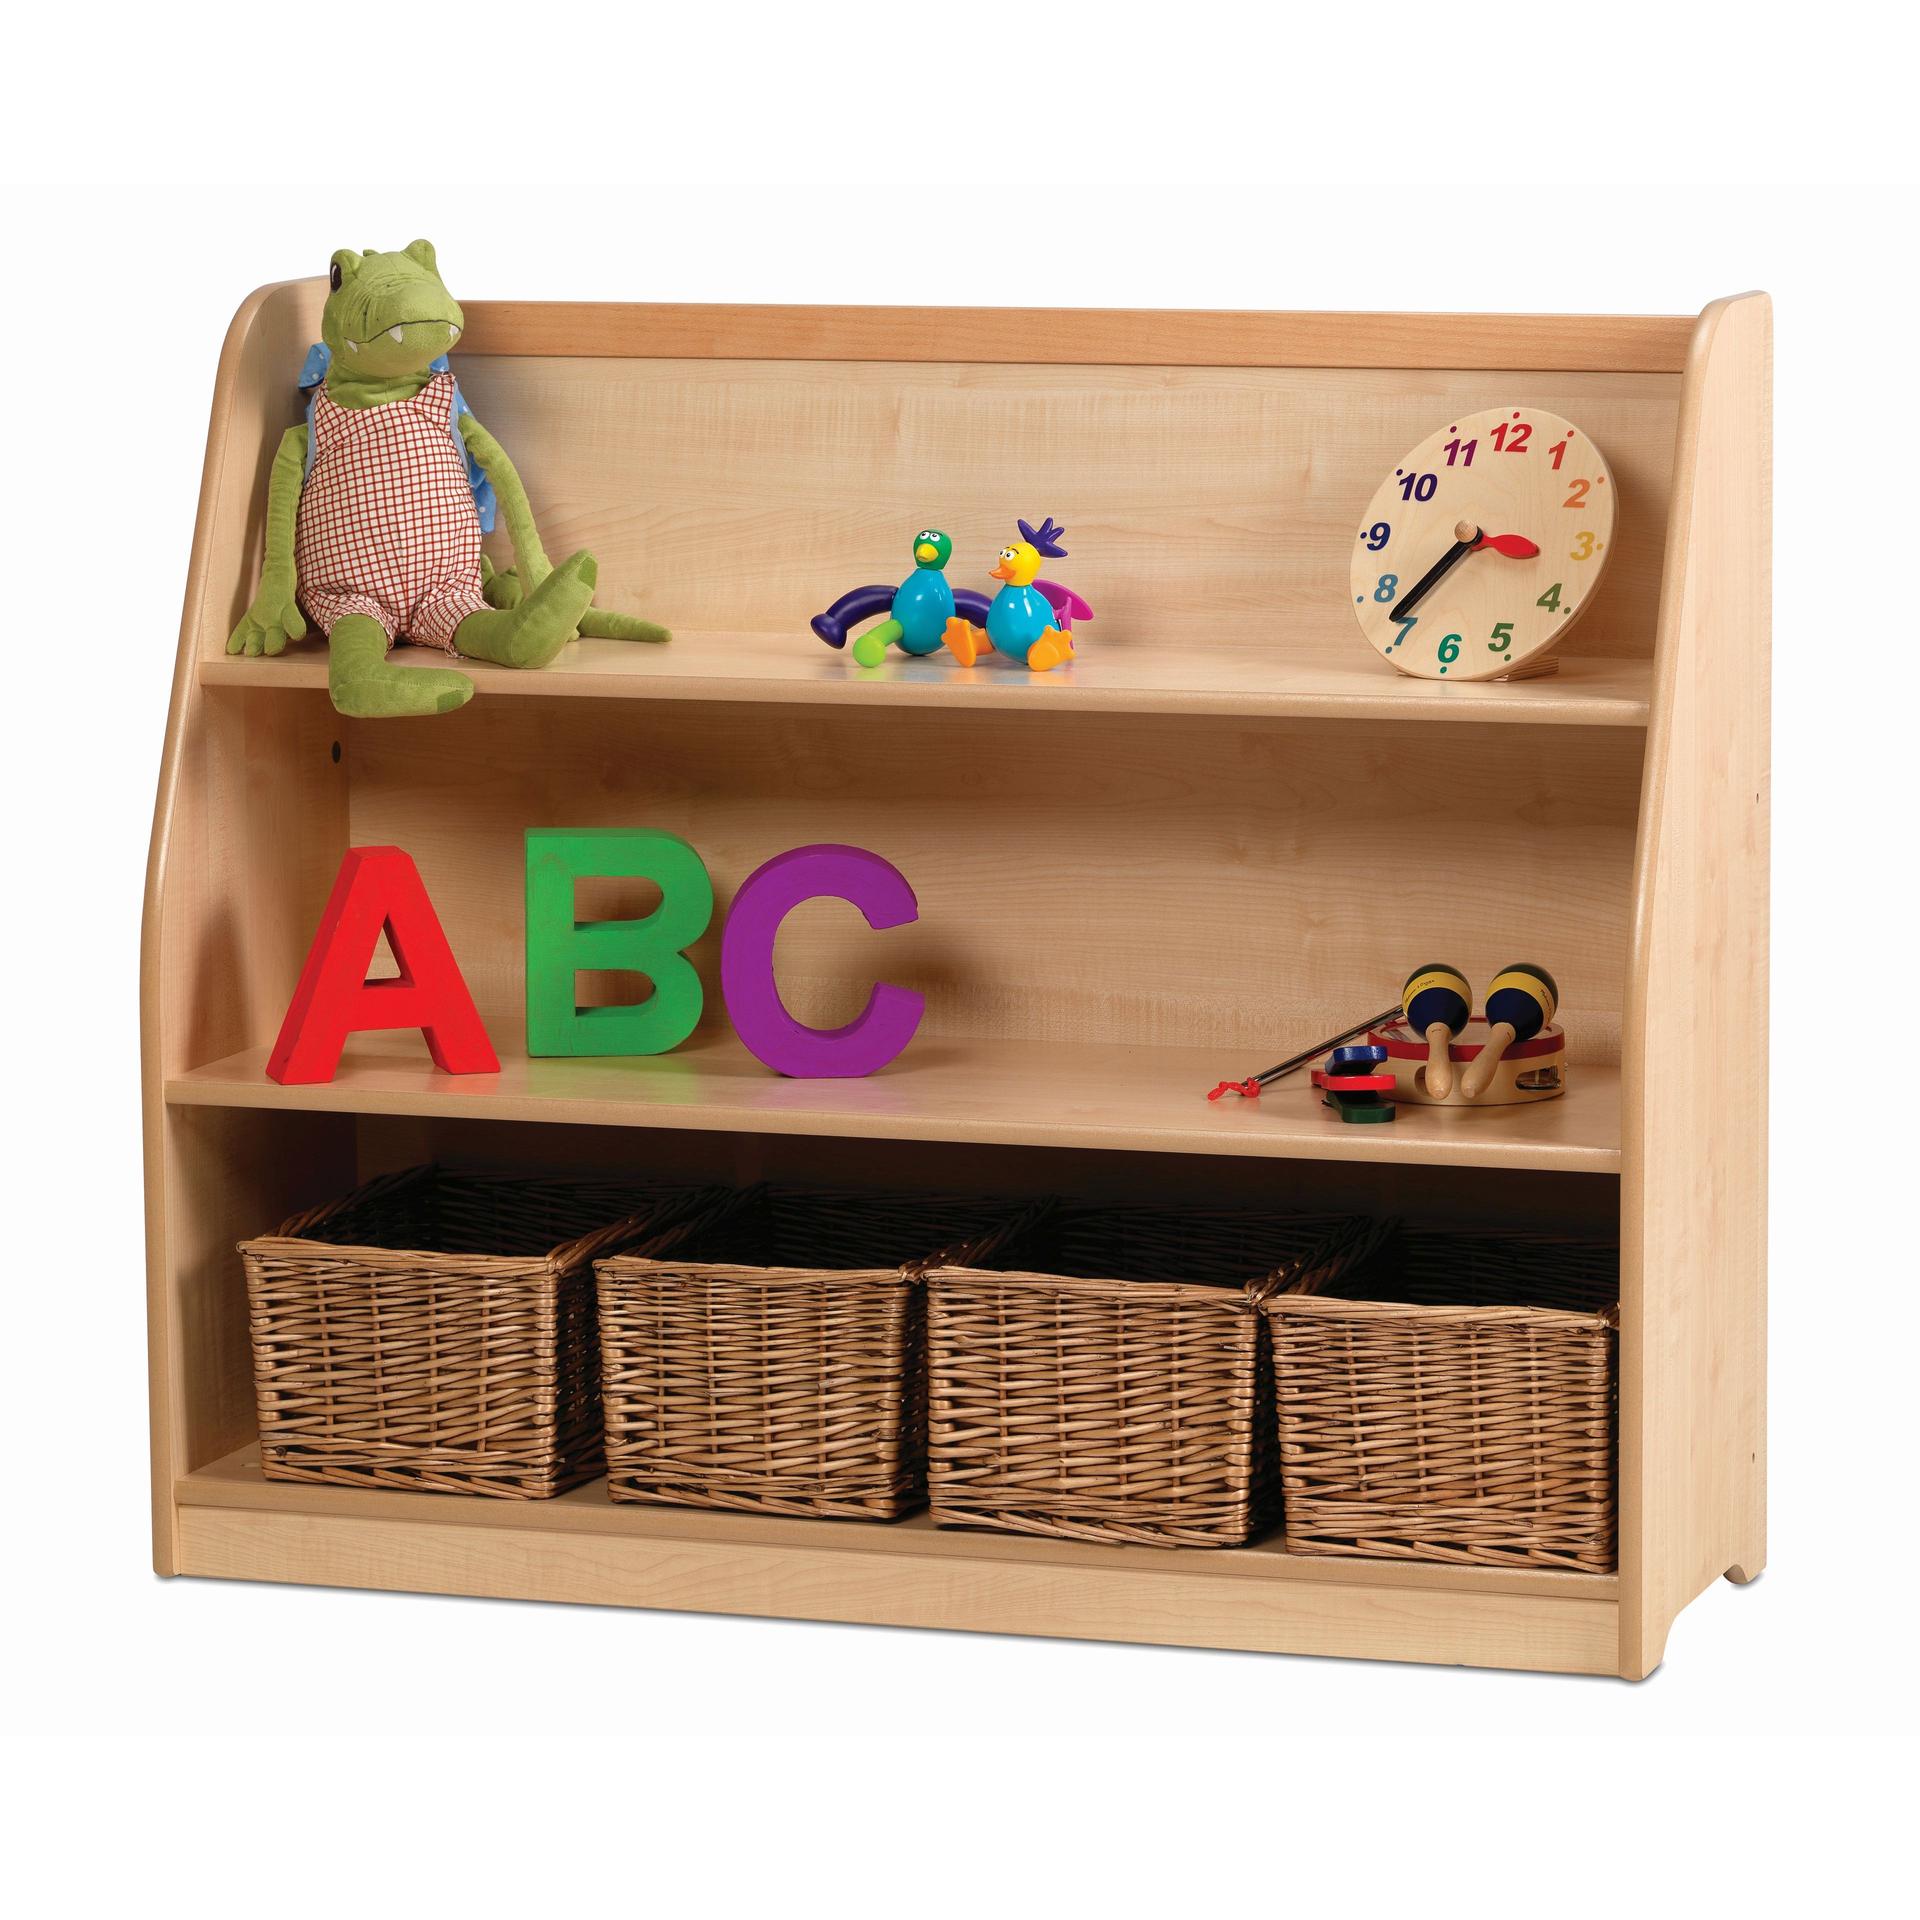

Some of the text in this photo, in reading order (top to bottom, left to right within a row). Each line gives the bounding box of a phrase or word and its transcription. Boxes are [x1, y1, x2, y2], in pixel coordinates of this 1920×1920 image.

[1443, 439, 1478, 467] 11
[1489, 423, 1533, 453] 12
[1548, 441, 1567, 470] 1
[1398, 472, 1438, 502] 10
[1562, 479, 1591, 508] 2
[1366, 522, 1391, 551] 9
[1570, 531, 1595, 561] 3
[1373, 574, 1398, 603] 8
[1536, 583, 1563, 613] 4
[1393, 616, 1418, 646] 7
[1487, 622, 1514, 652] 5
[1437, 633, 1462, 664] 6
